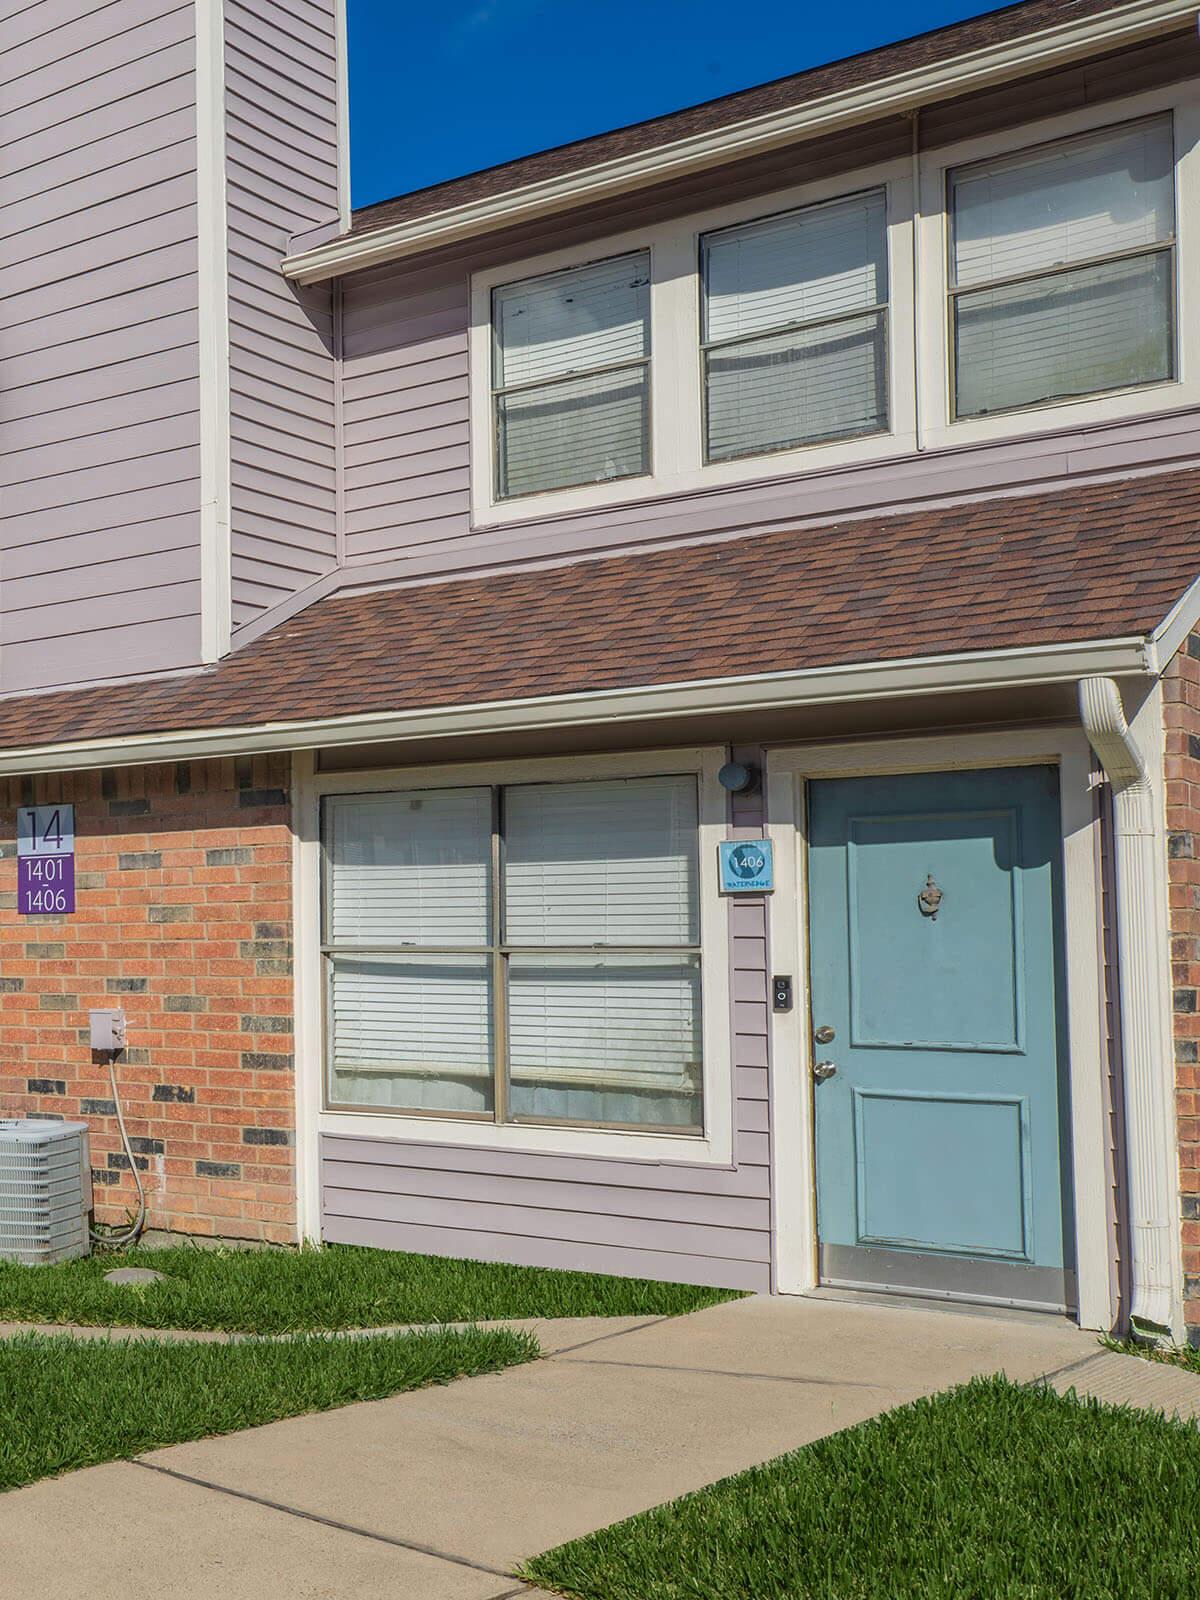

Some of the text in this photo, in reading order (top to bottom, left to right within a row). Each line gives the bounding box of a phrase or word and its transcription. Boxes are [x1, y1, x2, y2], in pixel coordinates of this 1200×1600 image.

[27, 809, 64, 851] 14
[26, 858, 63, 881] 1401
[734, 856, 763, 868] 1406
[26, 888, 66, 912] 1406
